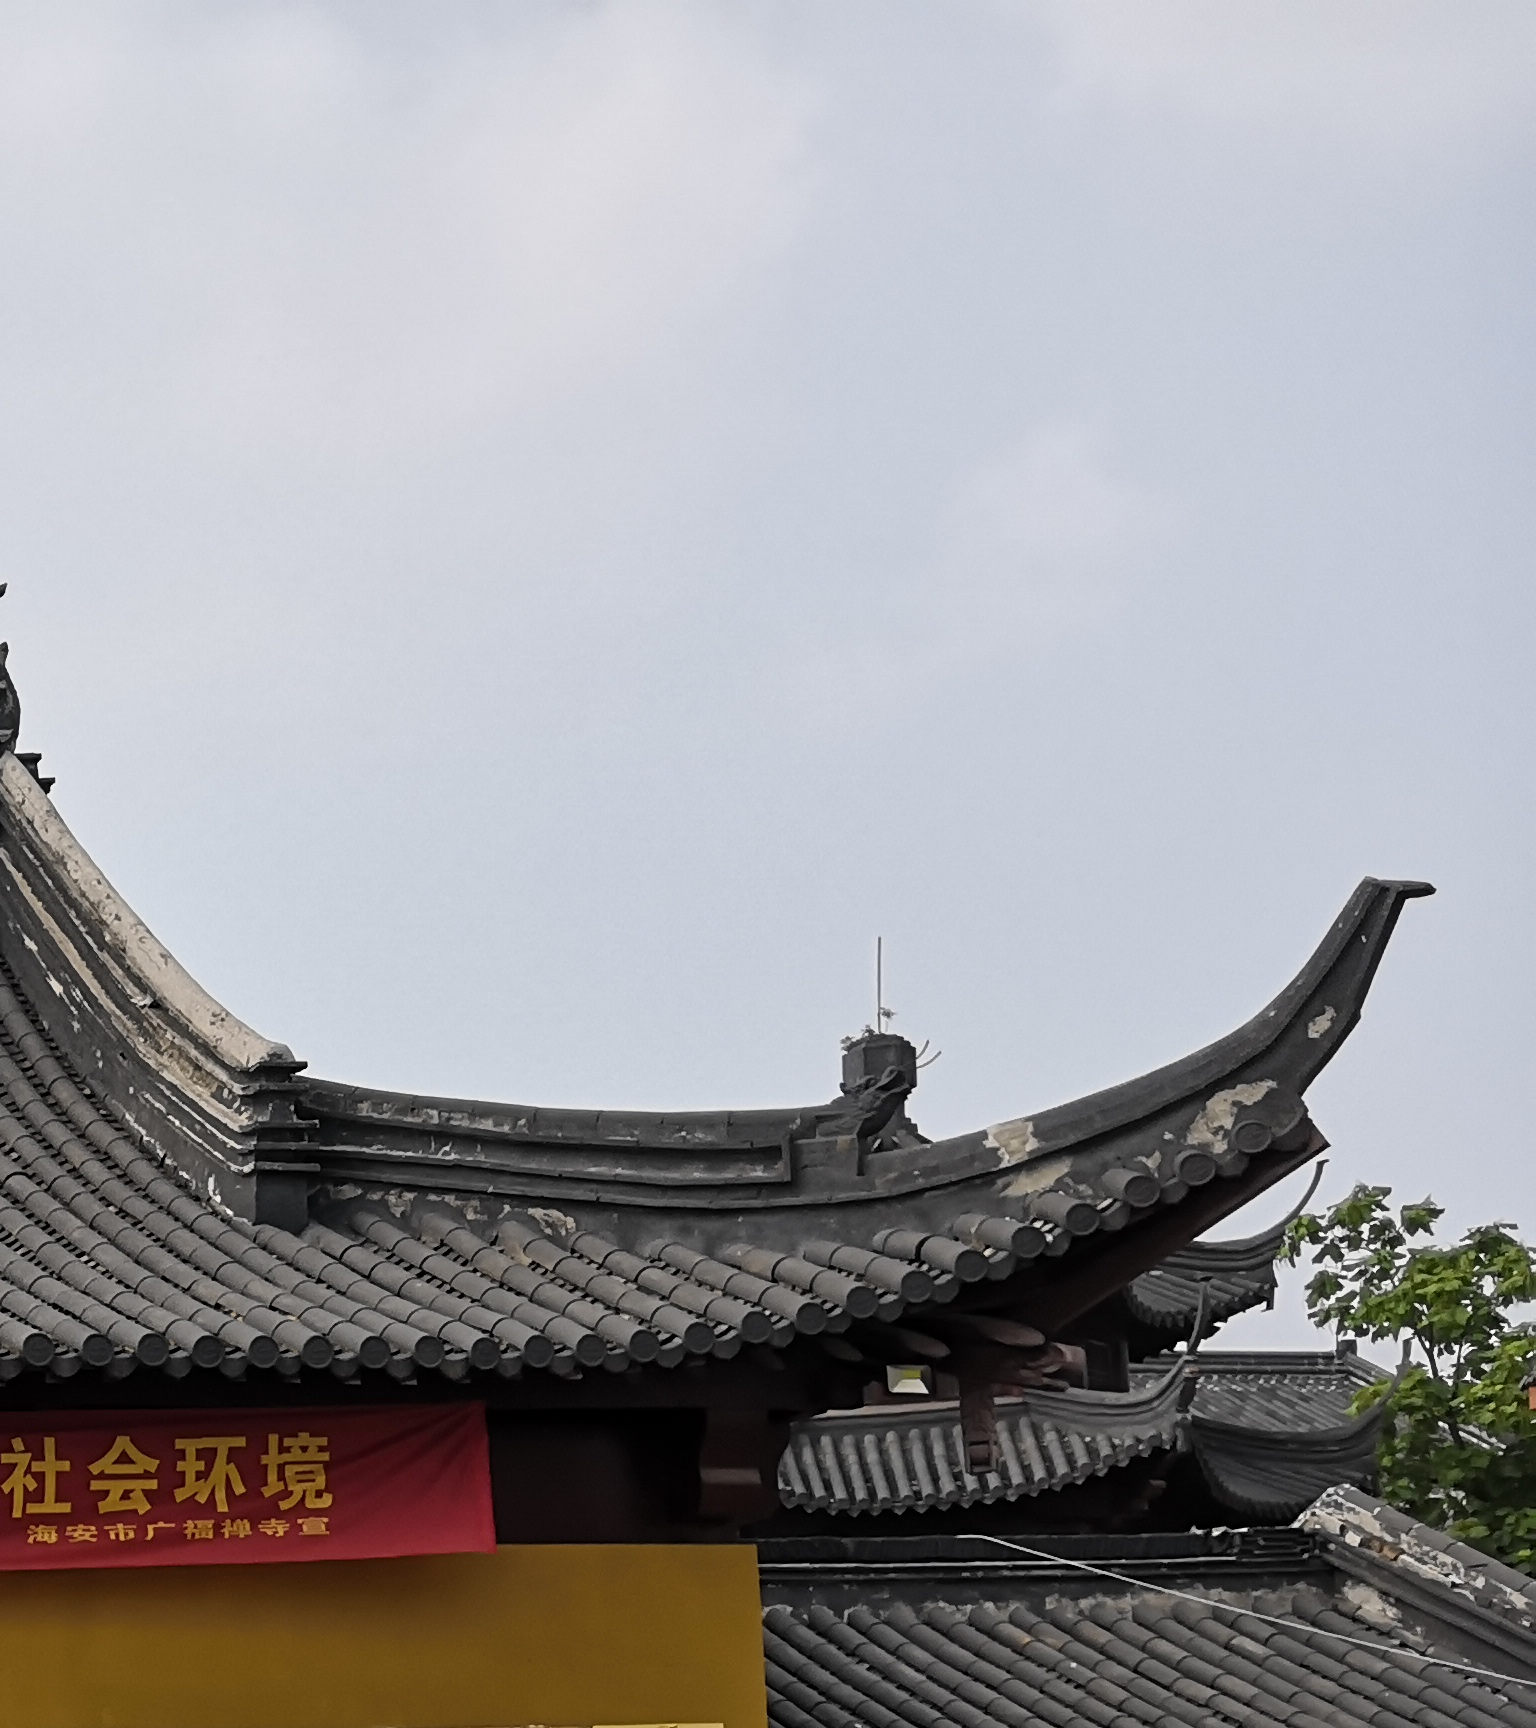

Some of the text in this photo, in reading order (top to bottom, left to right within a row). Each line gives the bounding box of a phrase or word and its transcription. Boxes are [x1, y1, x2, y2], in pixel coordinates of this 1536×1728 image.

[27, 1517, 330, 1545] 海安市广福禅寺宣
